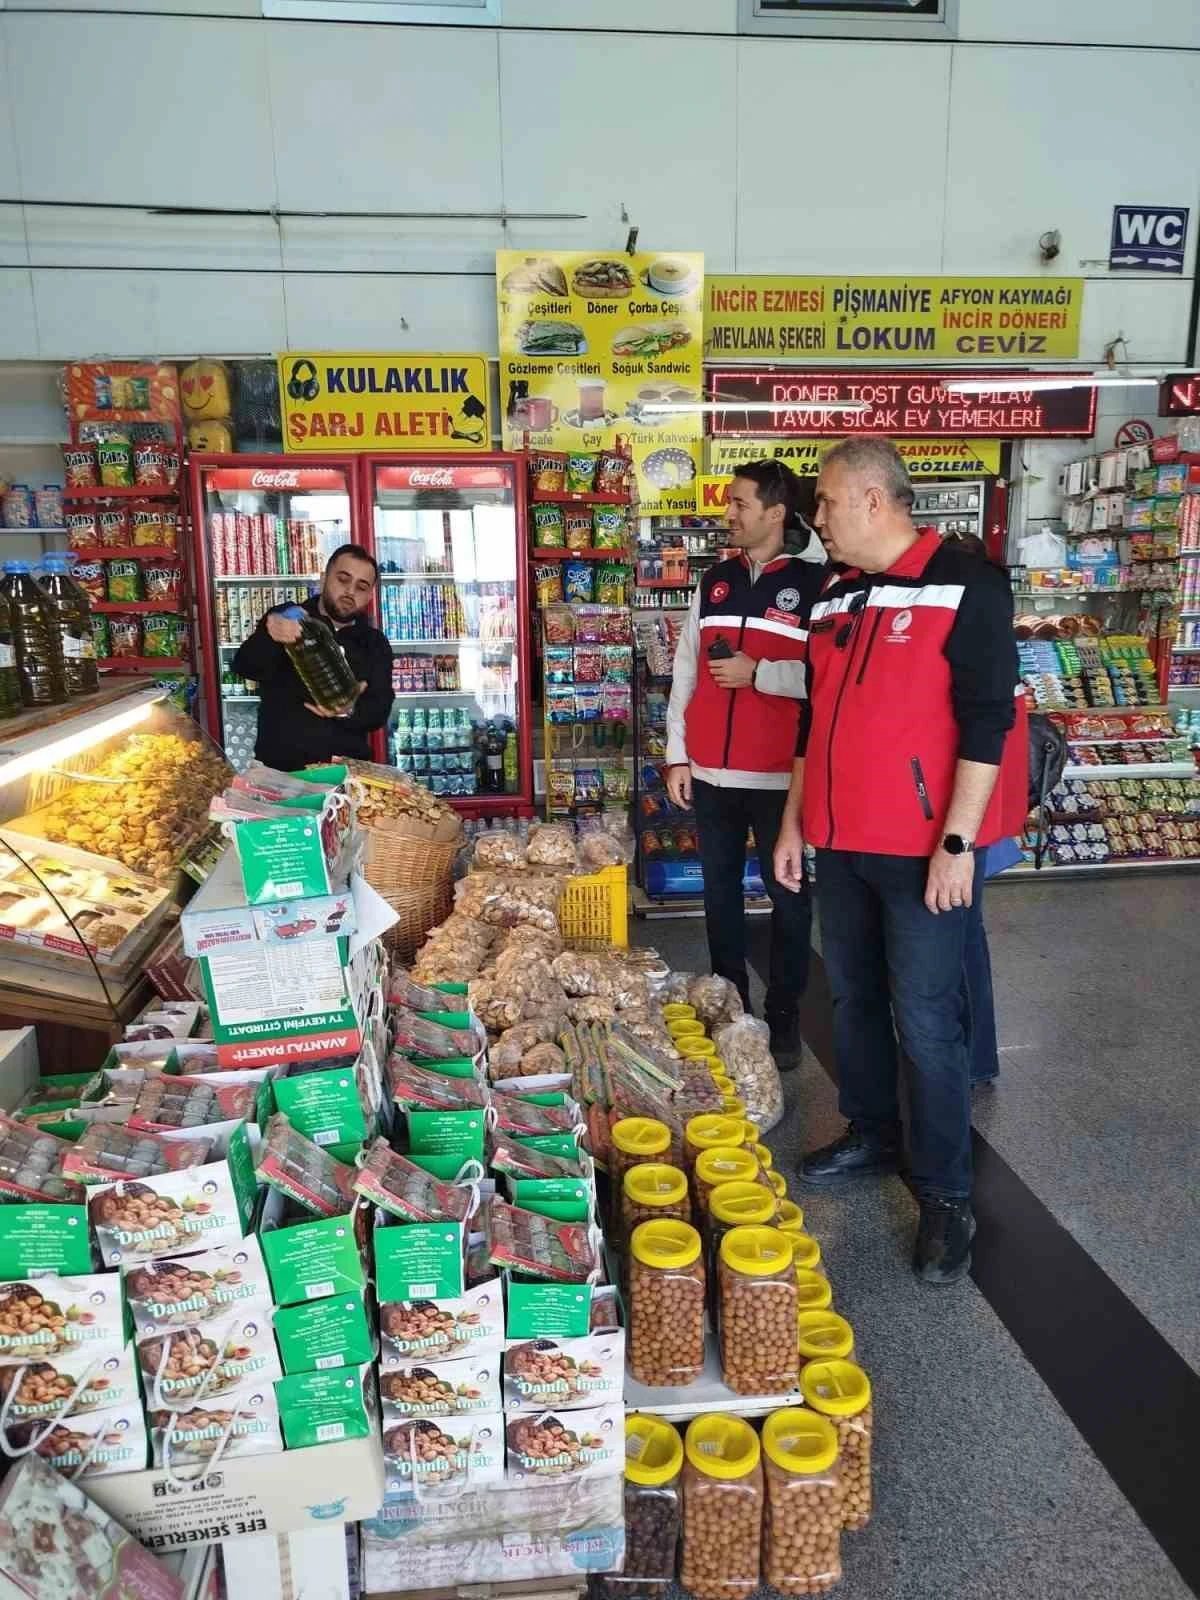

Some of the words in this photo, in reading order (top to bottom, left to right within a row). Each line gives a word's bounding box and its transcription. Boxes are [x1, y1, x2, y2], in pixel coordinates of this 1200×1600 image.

[1119, 213, 1182, 247] WC
[711, 286, 757, 313] İNCİR
[763, 285, 825, 313] EZMESİ
[832, 283, 931, 318] PİŞMANİYE
[939, 288, 993, 306] AFYON
[999, 285, 1072, 305] KAYMAĞI
[628, 302, 658, 317] Çorba
[943, 307, 993, 329] İNCİR
[999, 308, 1067, 330] DÖNERİ
[712, 326, 775, 350] MEVLANA
[779, 325, 826, 354] ŞEKERİ
[836, 326, 935, 351] LOKUM
[956, 332, 1048, 354] CEVİZ
[508, 362, 553, 375] Gözleme
[612, 361, 643, 376] Soğuk
[647, 361, 691, 374] Sandwic
[326, 367, 470, 393] KULAKLIK
[847, 385, 901, 404] TOST
[289, 411, 364, 444] ŞARJ
[374, 407, 450, 437] ALETİ
[773, 409, 836, 428] TAVUK
[842, 409, 899, 428] SICAK
[904, 410, 930, 428] EV
[938, 406, 1042, 428] YEMEKLERİ
[512, 432, 553, 445] Necafe
[583, 433, 602, 447] Çay
[720, 447, 768, 458] TEKEL
[908, 458, 985, 472] GÖZLEME
[641, 499, 663, 511] ahat
[327, 1013, 344, 1026] TV
[286, 1035, 347, 1056] AVANTAJ
[235, 1517, 267, 1535] EFE
